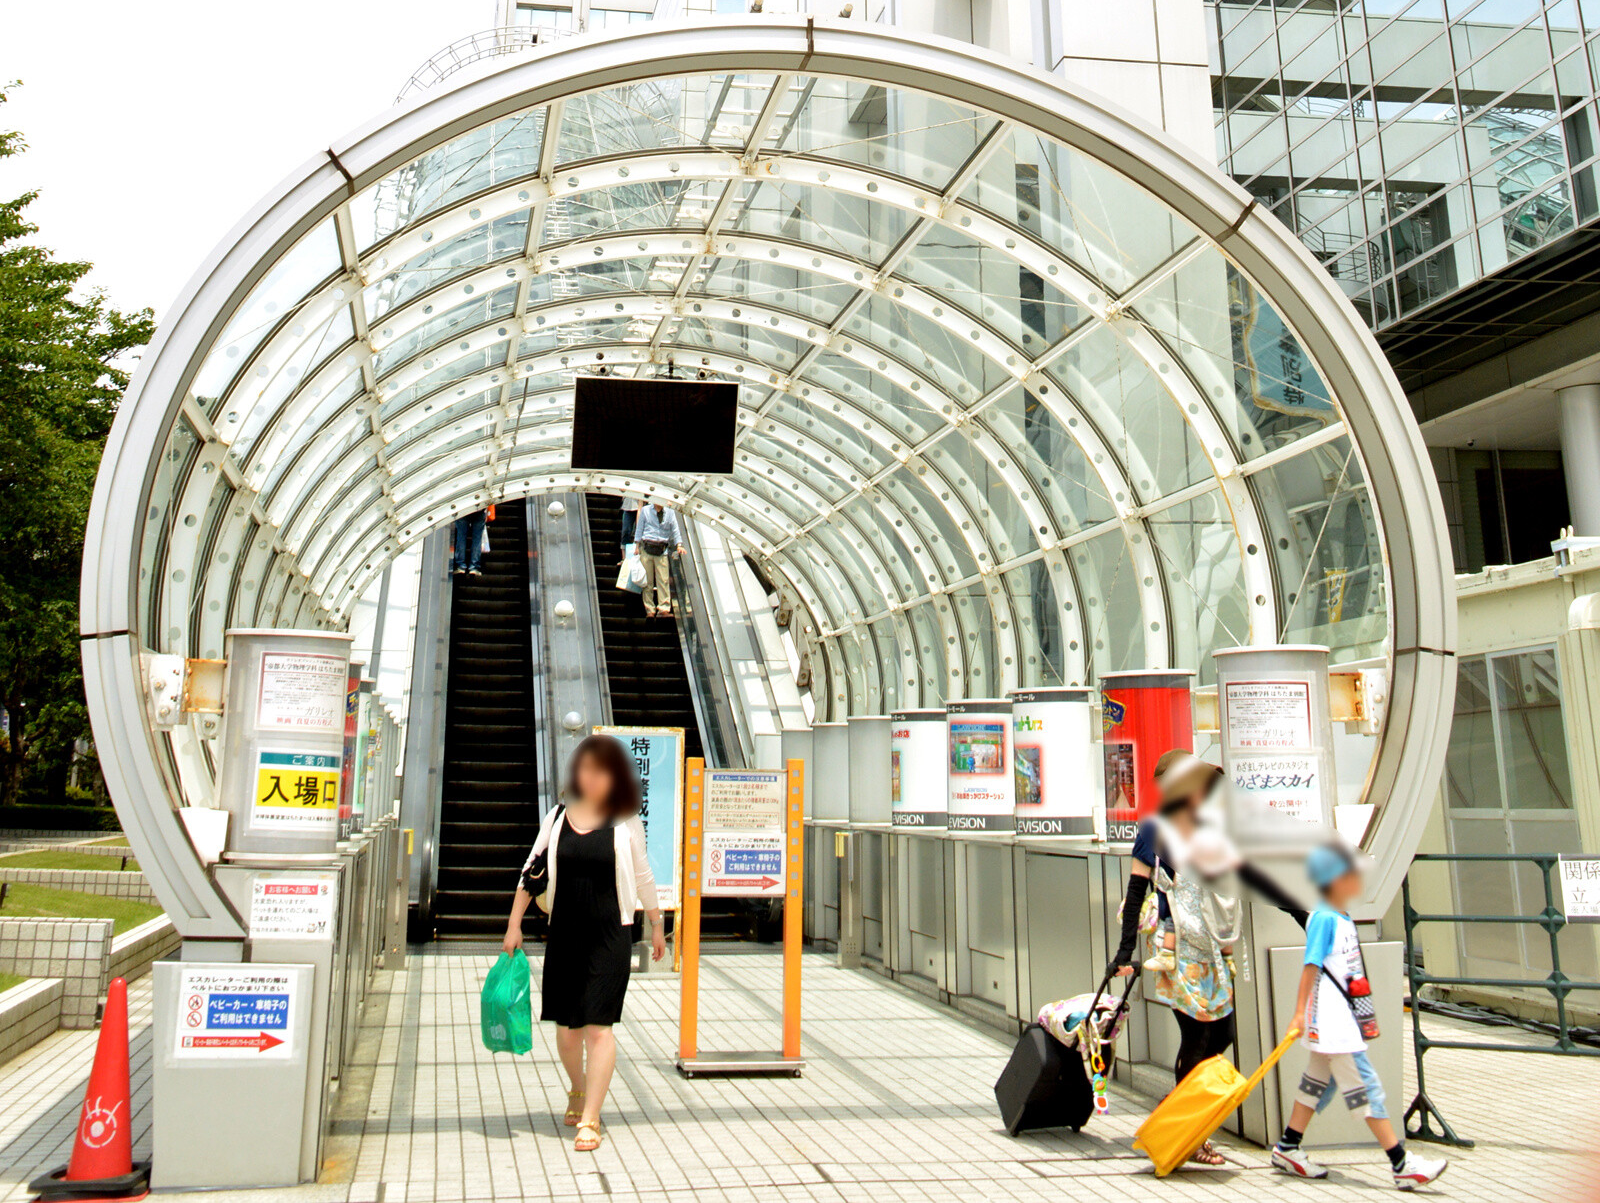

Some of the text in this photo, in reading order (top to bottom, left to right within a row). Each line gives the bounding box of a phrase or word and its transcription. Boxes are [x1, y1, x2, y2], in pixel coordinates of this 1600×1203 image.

[292, 754, 325, 767] ご案内
[1236, 773, 1314, 790] めざまスカイ
[262, 775, 336, 805] 入場口
[726, 854, 780, 862] ベビーカー・車椅子の
[728, 863, 777, 871] ご利用はできません
[209, 999, 287, 1011] ベビーカー・車椅子の
[212, 1013, 282, 1025] ご利用はできません
